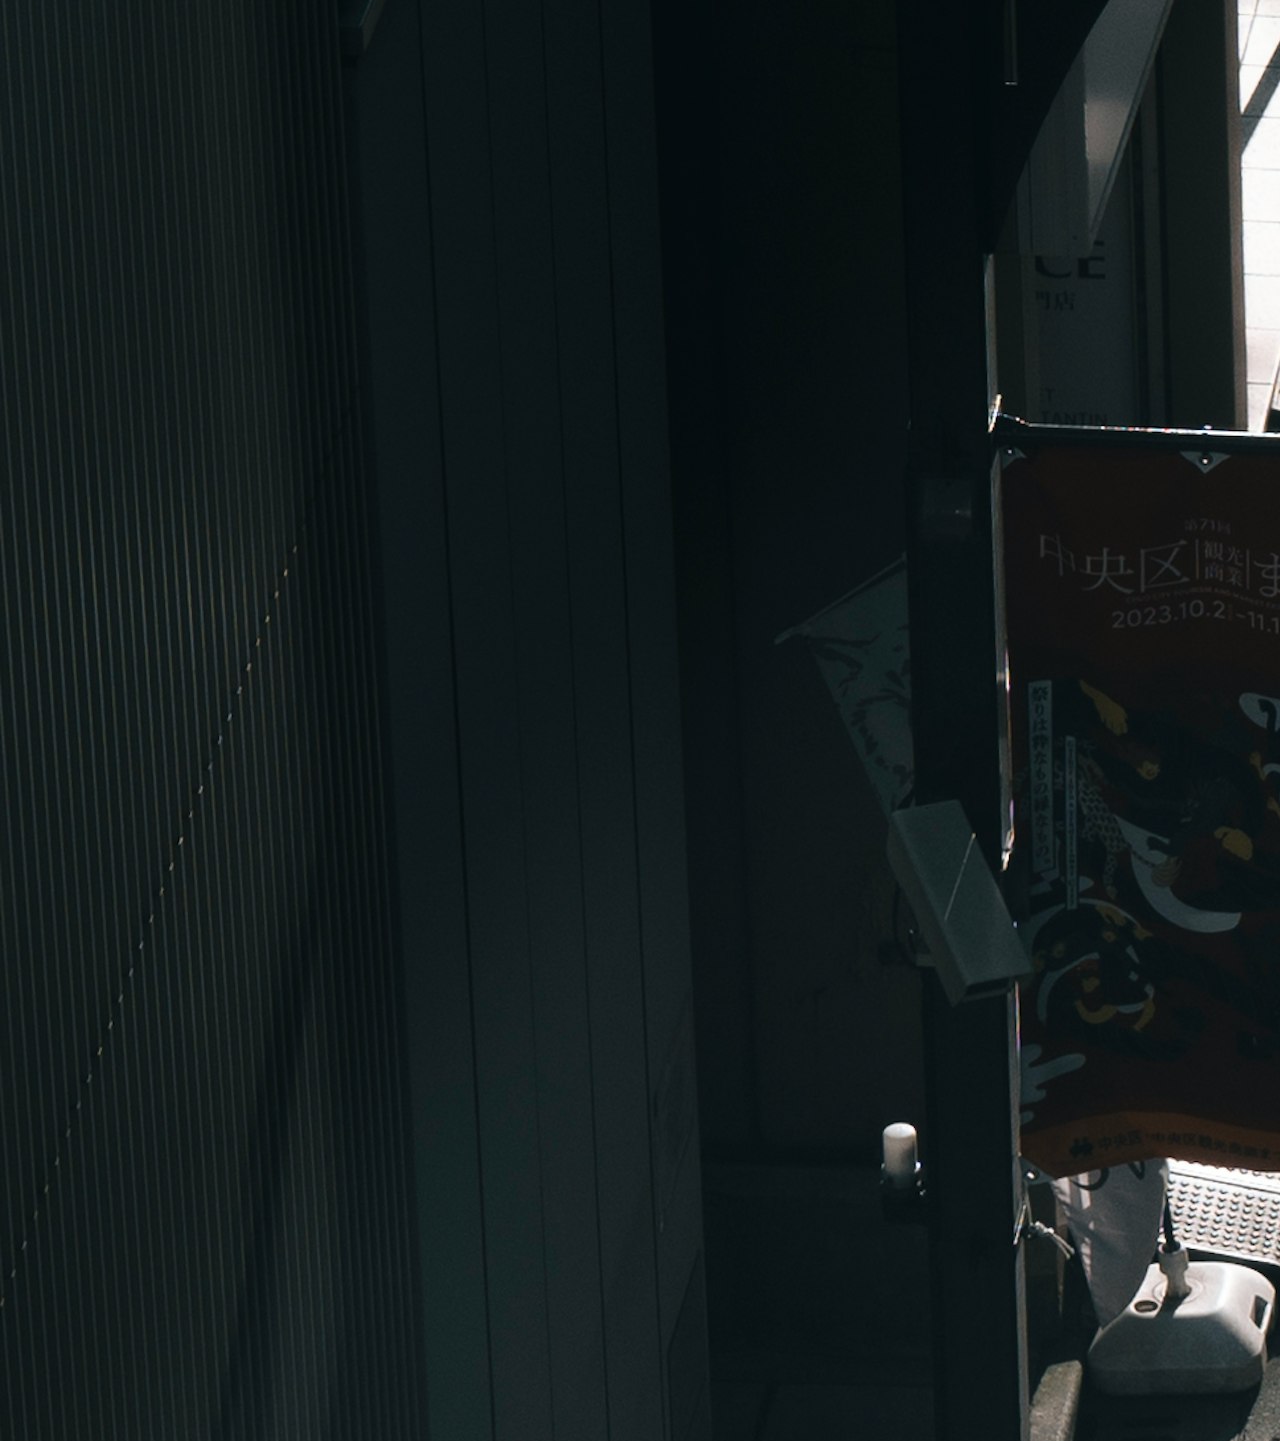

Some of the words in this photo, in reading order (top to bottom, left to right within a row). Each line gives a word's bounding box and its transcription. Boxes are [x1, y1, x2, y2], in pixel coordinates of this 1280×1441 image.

[1039, 532, 1192, 594] 中央区
[1203, 539, 1244, 588] 観光商業
[1112, 599, 1227, 630] 2023.10.2
